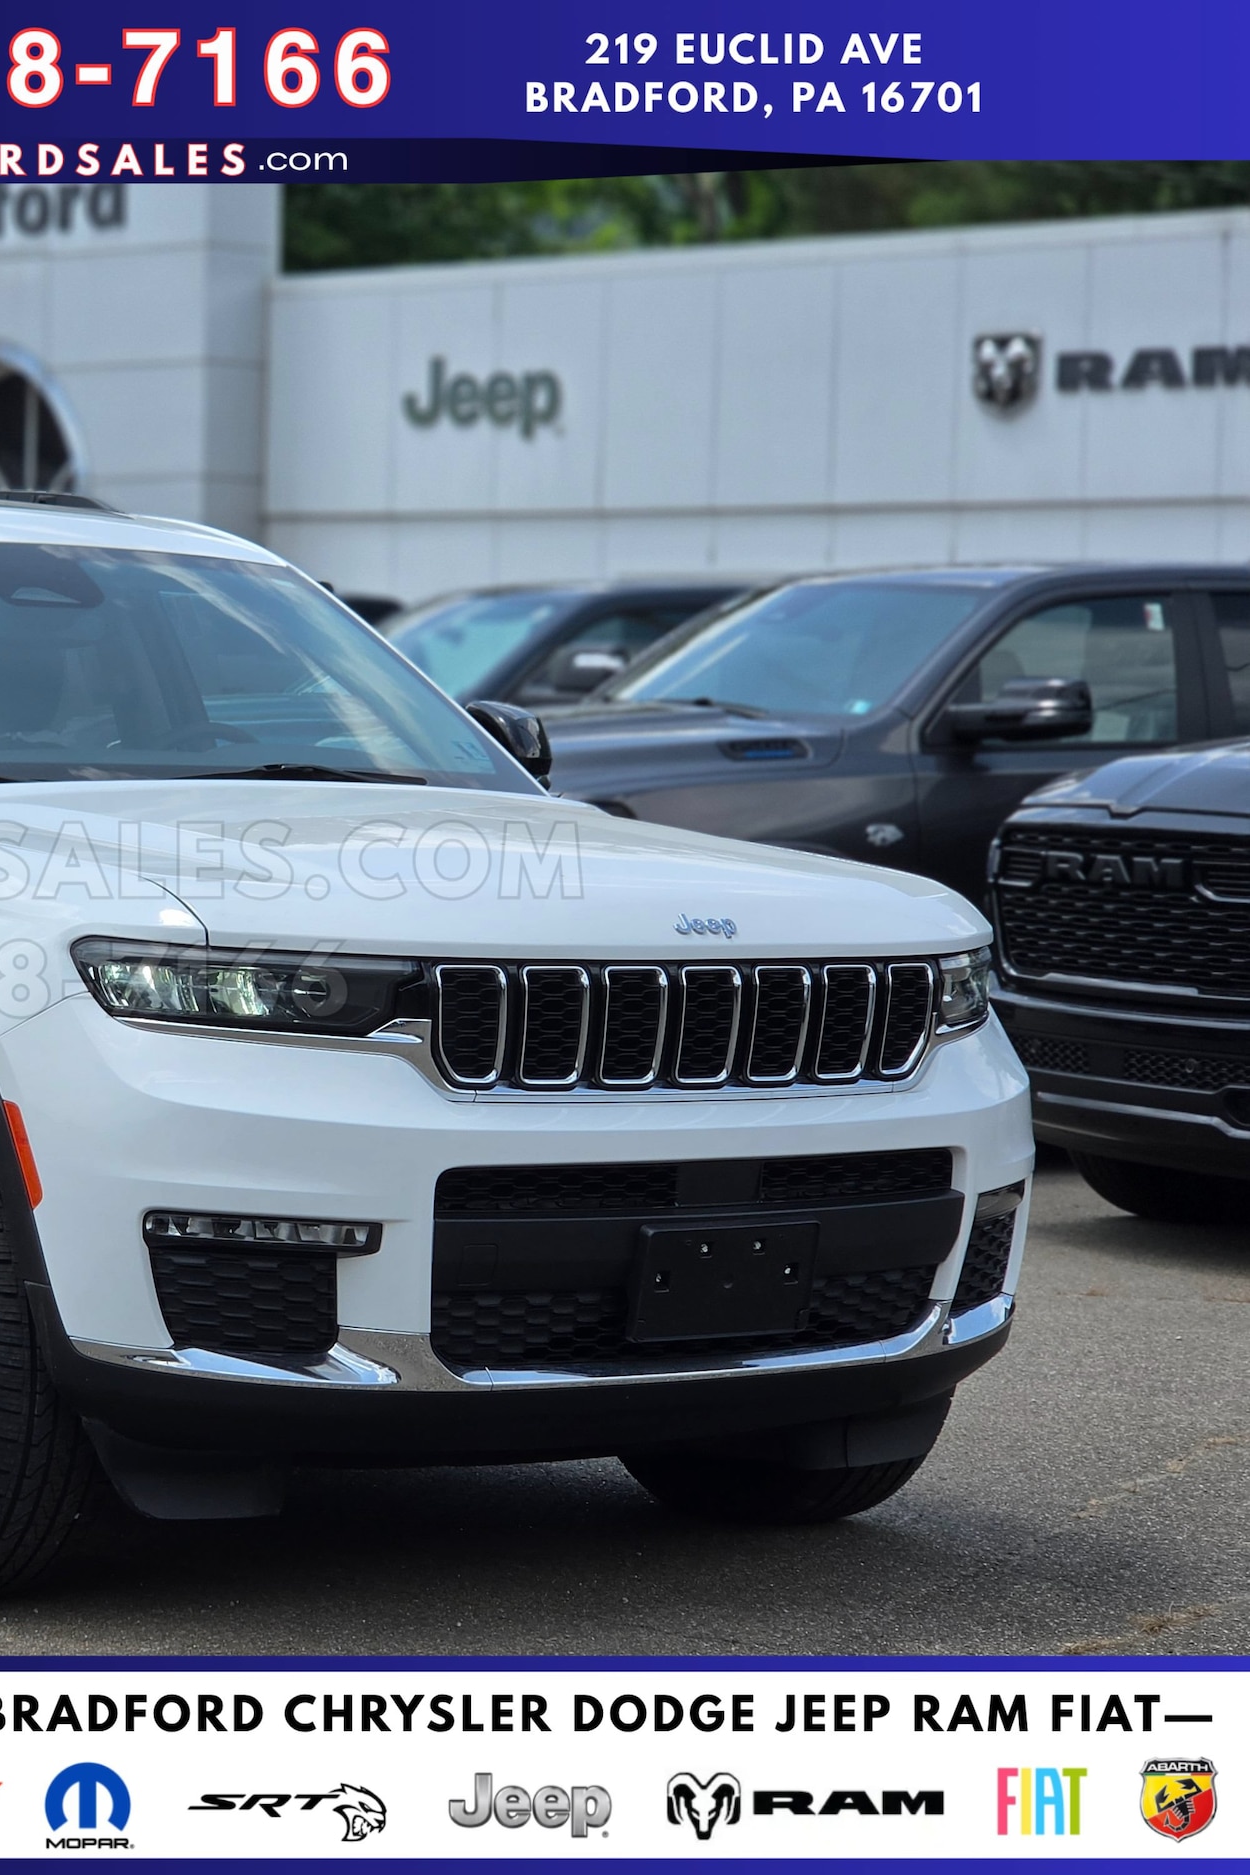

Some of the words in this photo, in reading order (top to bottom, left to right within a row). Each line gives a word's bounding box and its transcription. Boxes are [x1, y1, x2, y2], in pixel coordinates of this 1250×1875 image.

[1055, 346, 1250, 393] RAM
[402, 355, 562, 441] Jeep
[1047, 850, 1184, 886] RAM
[673, 913, 737, 939] Jeep
